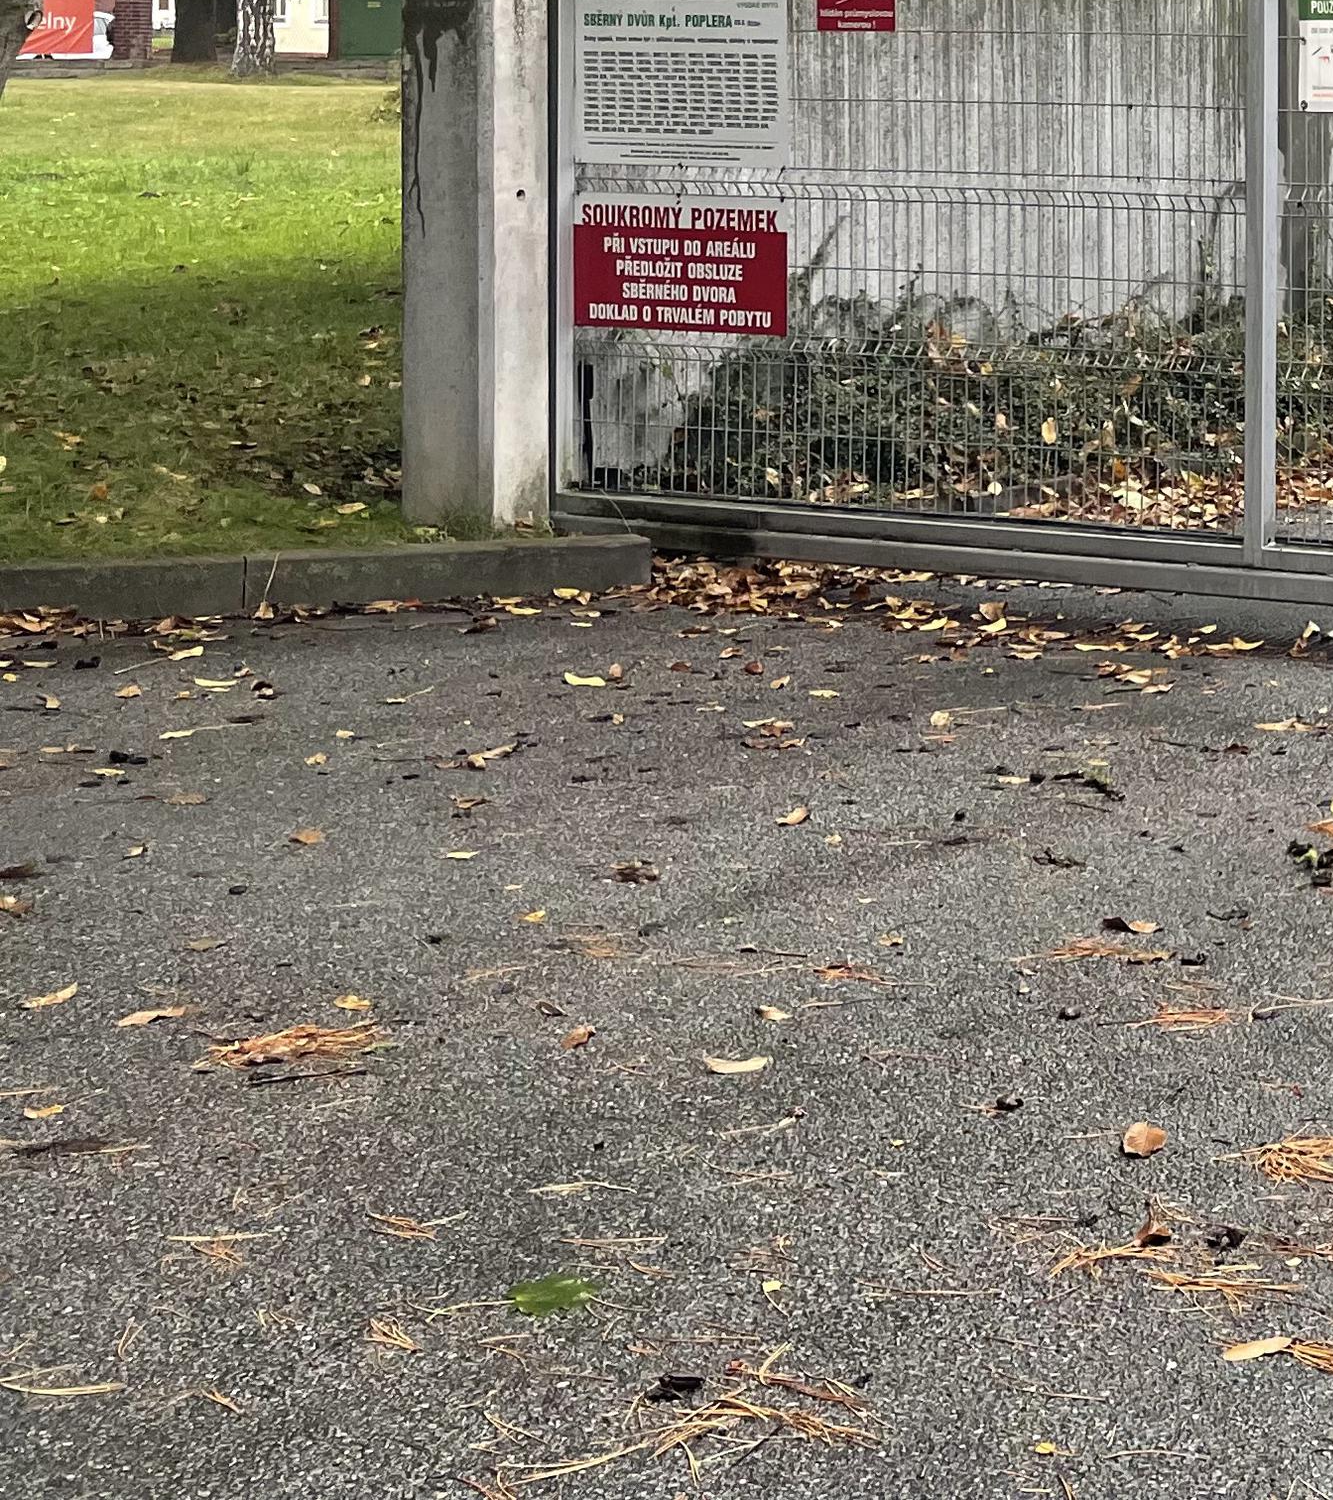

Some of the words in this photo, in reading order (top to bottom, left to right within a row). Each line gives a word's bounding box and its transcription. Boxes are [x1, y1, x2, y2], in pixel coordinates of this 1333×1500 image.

[583, 9, 623, 27] SBĚRNÝ
[627, 9, 655, 27] DVŮR
[659, 13, 680, 30] Kpt.
[685, 14, 733, 28] POPLERA
[581, 201, 684, 229] SOUKROMÝ
[691, 207, 779, 233] POZEMEK
[603, 232, 625, 254] PŘI
[629, 238, 679, 256] VSTUPU
[684, 240, 701, 256] DO
[706, 237, 756, 259] AREÁLU
[616, 255, 683, 278] PŘEDLOŽIT
[687, 262, 743, 281] OBSLUZE
[622, 278, 688, 301] SBĚRNÉHO
[692, 285, 737, 304] DVORA
[589, 303, 638, 321] DOKLAD
[642, 306, 651, 322] O
[656, 303, 715, 326] TRVALÉM
[719, 309, 772, 328] POBYTU
